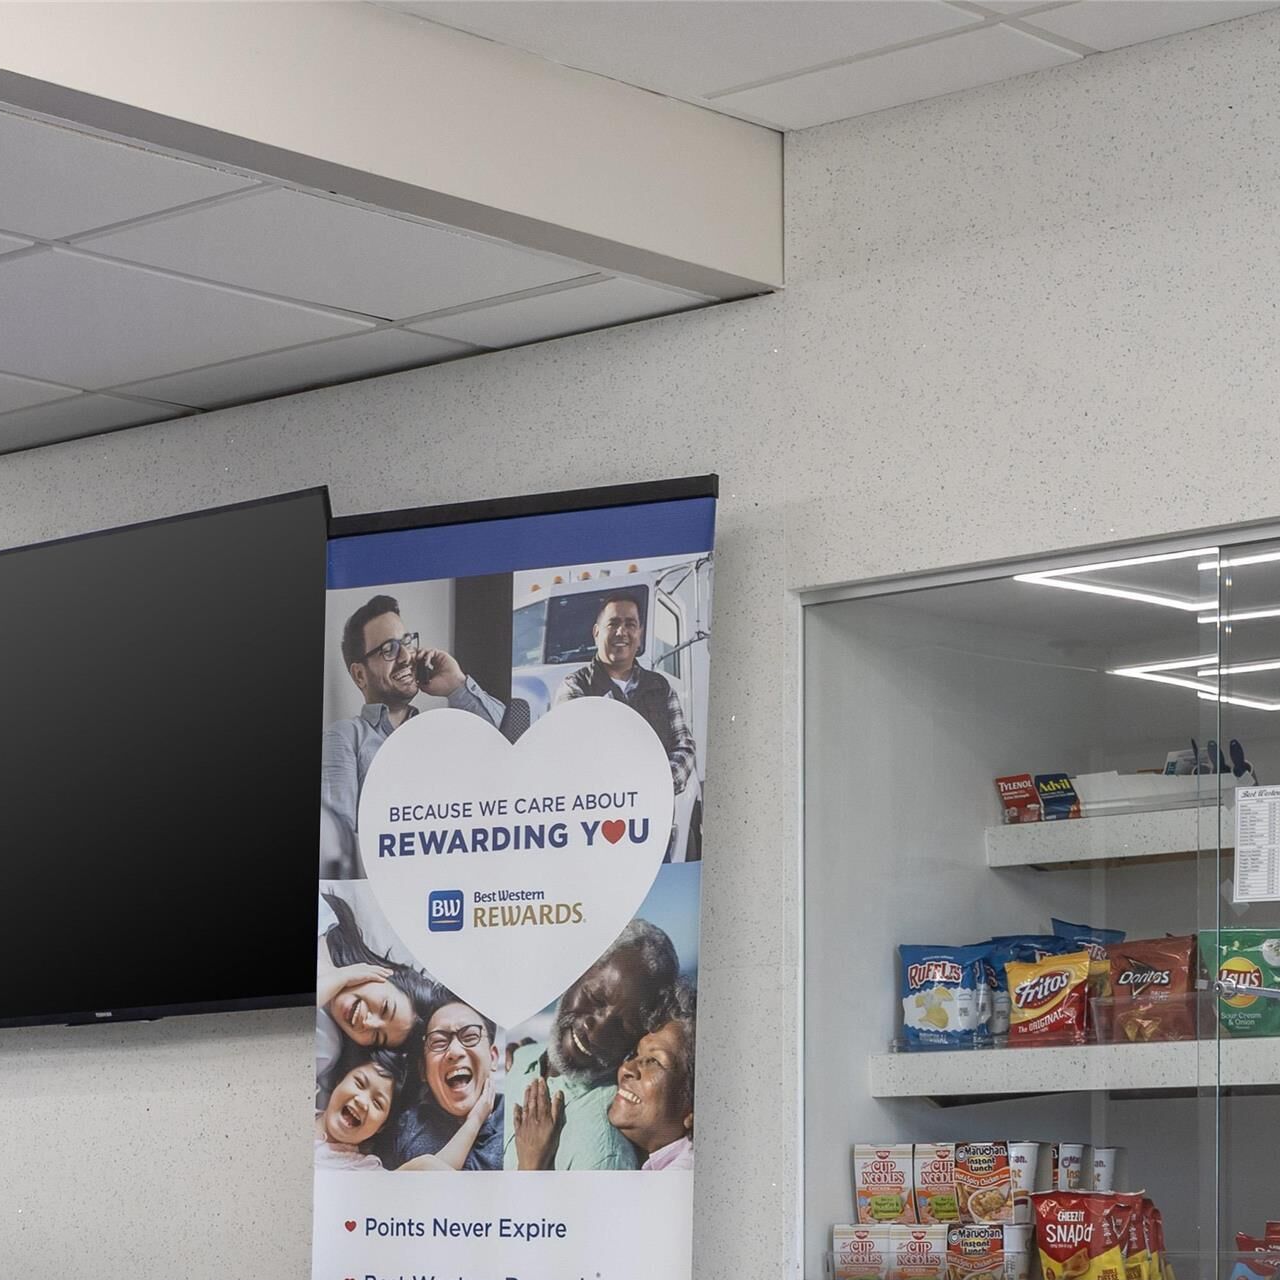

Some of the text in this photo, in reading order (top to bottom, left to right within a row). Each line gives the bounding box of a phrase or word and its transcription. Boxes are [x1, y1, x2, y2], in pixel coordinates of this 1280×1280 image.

[998, 780, 1033, 792] TYLENOL
[1040, 778, 1071, 792] Advil
[389, 791, 638, 822] BECAUSE WE CARE ABOUT
[379, 823, 568, 858] REWARDING
[474, 890, 545, 903] Best Western
[431, 899, 461, 917] BW
[1119, 970, 1171, 985] Doritos
[1016, 972, 1069, 1008] Fritos
[965, 1145, 1007, 1156] Maruchan
[871, 1160, 896, 1173] CUP
[967, 1157, 996, 1165] Instant
[970, 1164, 993, 1172] Lunch
[862, 1171, 905, 1185] NOODLES
[365, 1218, 567, 1242] Points Never Expire
[959, 1228, 1002, 1239] Maruchan
[850, 1241, 874, 1253] CUP
[907, 1241, 932, 1253] CUP
